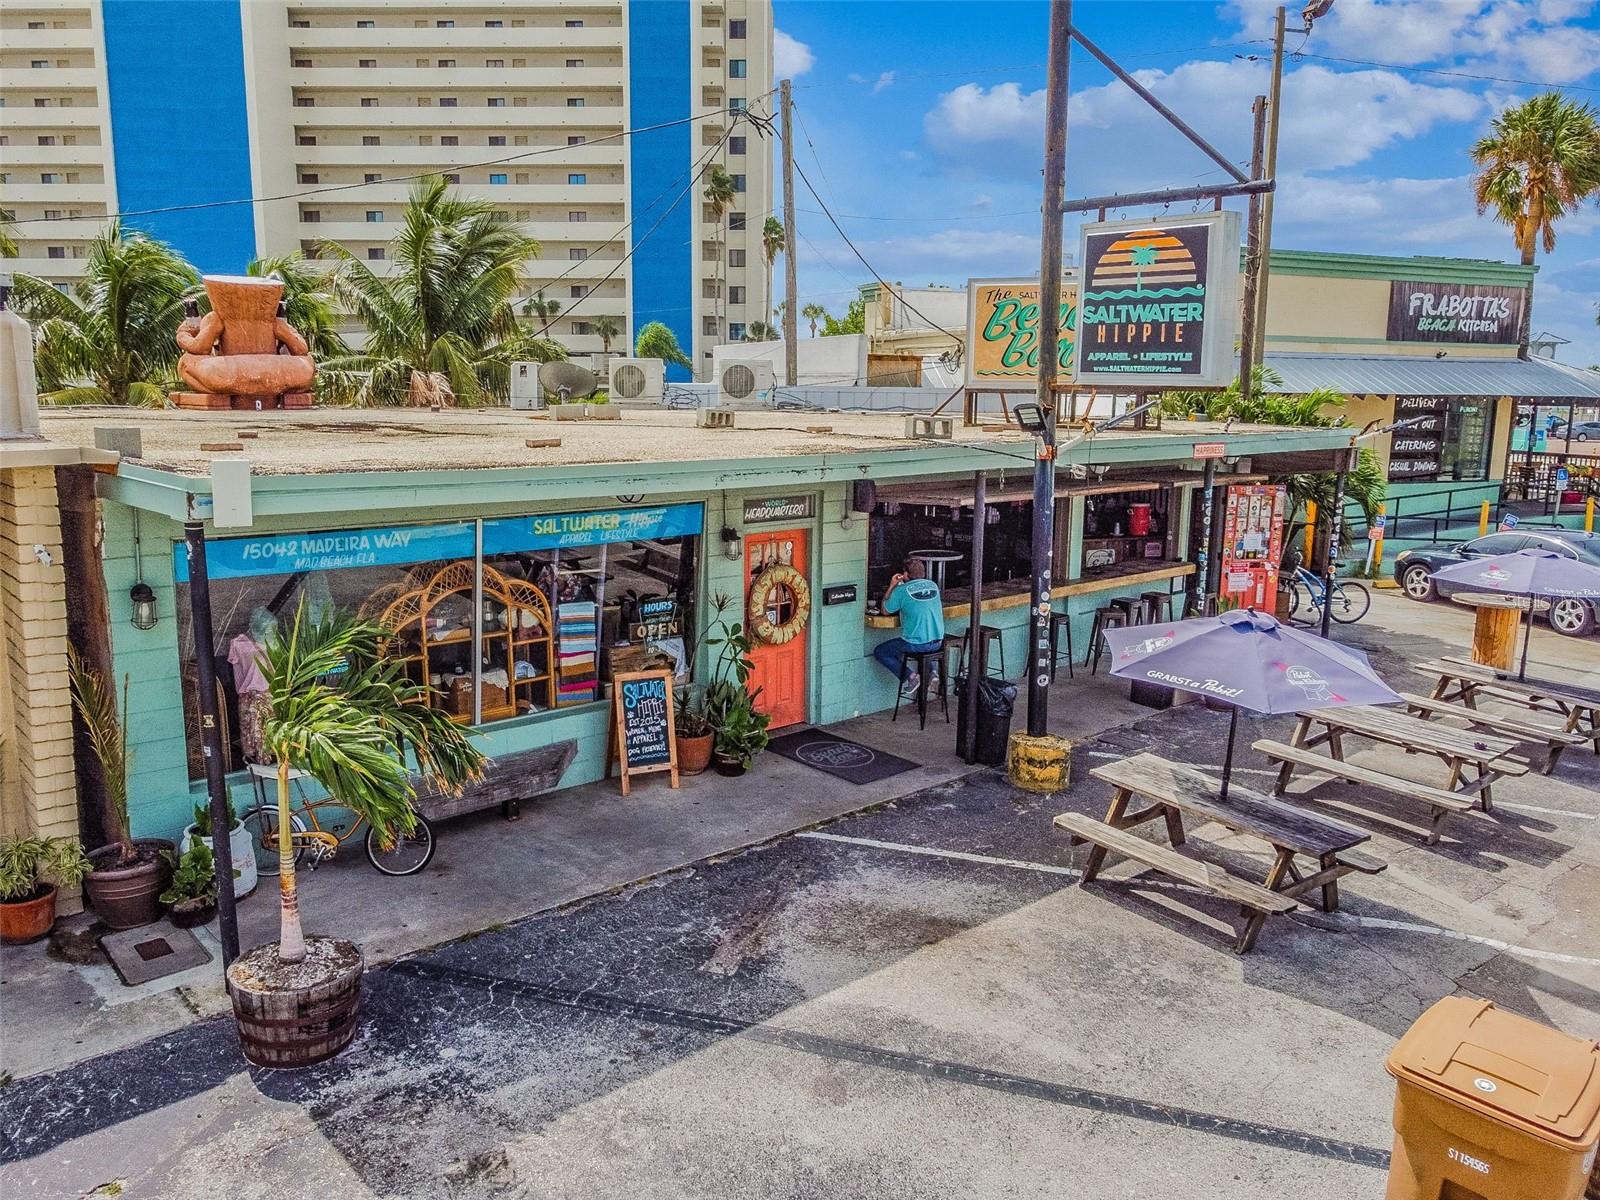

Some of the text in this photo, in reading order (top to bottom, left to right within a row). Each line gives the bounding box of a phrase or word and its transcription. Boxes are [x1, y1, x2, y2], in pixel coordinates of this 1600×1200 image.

[986, 288, 1013, 304] The
[1019, 291, 1067, 299] SALTR
[1082, 302, 1204, 324] SALTWATER
[1409, 292, 1510, 319] FRABOTTA'S
[1097, 323, 1184, 343] HIPPIE
[1457, 318, 1499, 333] KITCHEN
[1087, 352, 1193, 362] APPAREL LIFESTYLE
[1401, 397, 1438, 408] DELIVERY
[1421, 419, 1437, 429] OUT
[1195, 446, 1224, 455] HAPPINESS
[1394, 440, 1436, 451] CATERING
[1389, 461, 1438, 472] CASUAL DINING
[744, 503, 805, 520] HEADQUARTERS
[533, 513, 621, 535] SALTWATER
[559, 528, 639, 545] APPAREL LIFESTYLE
[242, 530, 412, 560] 15042 MADEIRA WAY
[294, 551, 376, 569] MAD BEACH FLA
[643, 600, 673, 614] HOURS
[637, 621, 678, 638] OPEN
[1146, 669, 1192, 689] GRABST
[1200, 678, 1244, 698] Pabst!
[637, 698, 665, 719] HIPPIE
[632, 732, 658, 745] APPAREL
[627, 747, 640, 756] DOG
